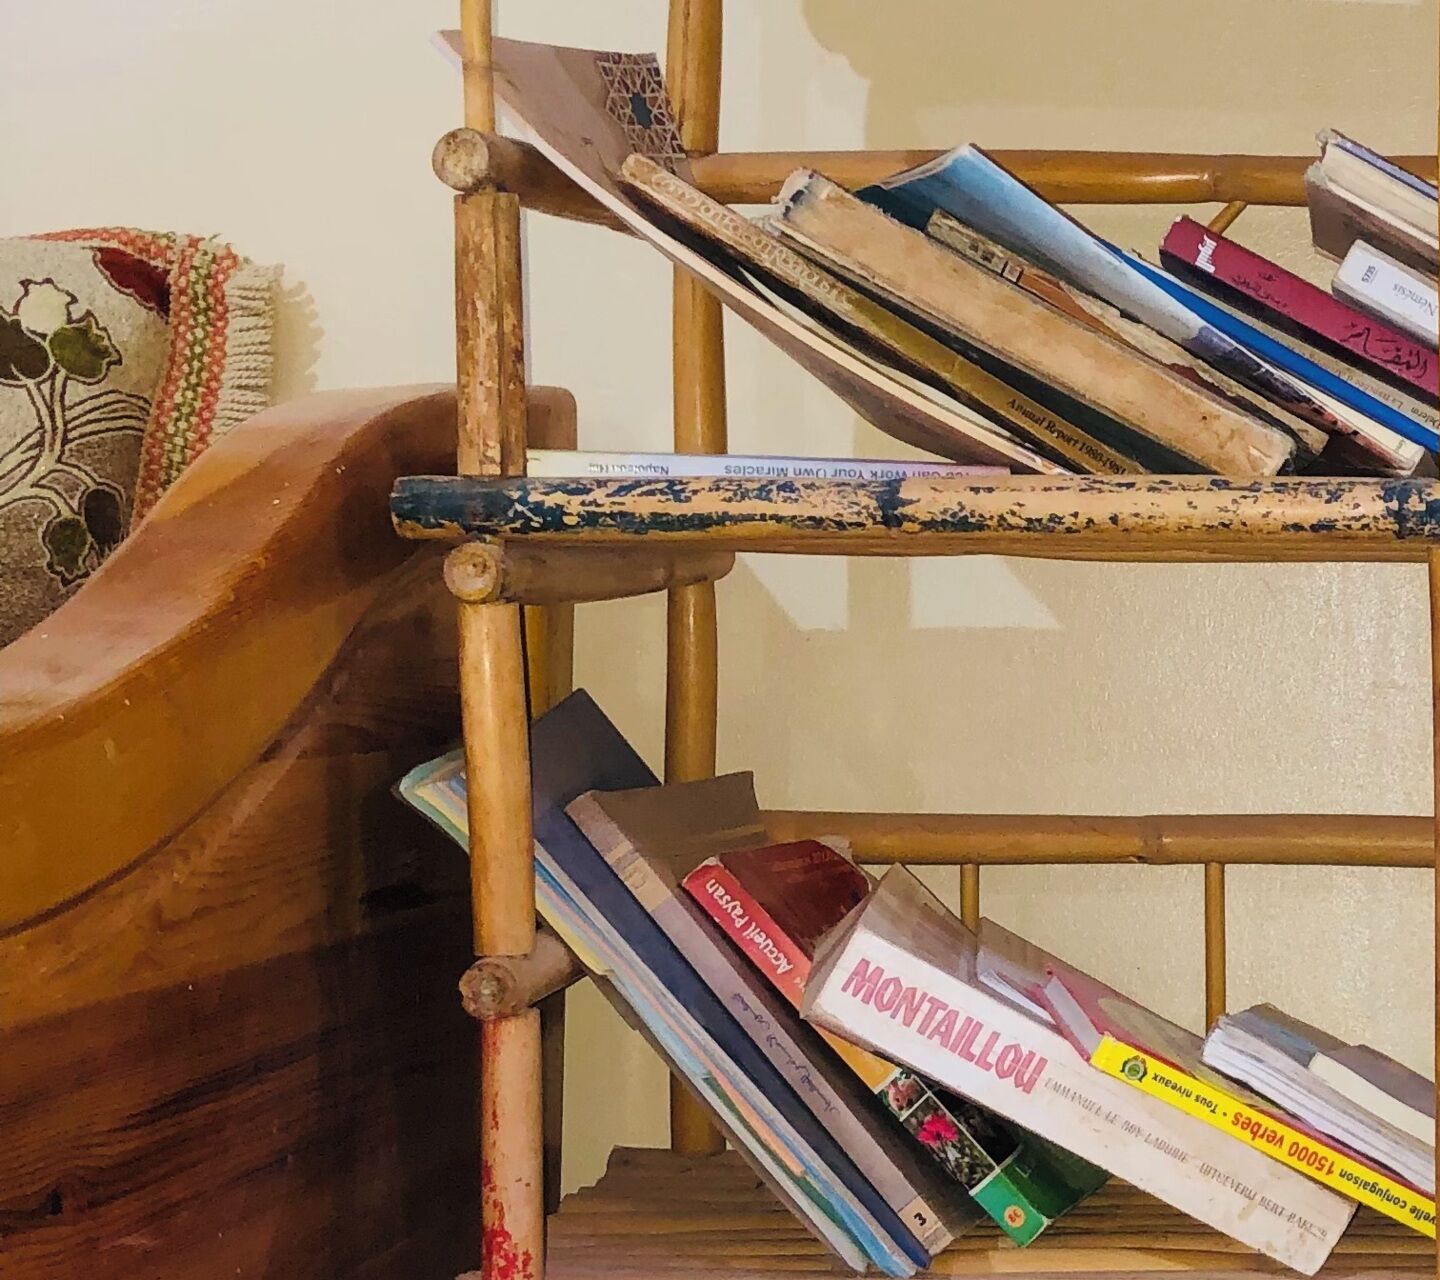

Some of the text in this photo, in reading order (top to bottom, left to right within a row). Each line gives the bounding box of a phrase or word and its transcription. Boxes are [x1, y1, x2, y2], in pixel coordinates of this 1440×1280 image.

[1390, 280, 1439, 317] Némésis
[1005, 396, 1046, 427] Annual
[1042, 419, 1081, 449] Report
[611, 462, 668, 475] Napoleon
[724, 464, 787, 478] Miracles
[793, 466, 826, 478] Own
[831, 466, 863, 479] Your
[870, 468, 907, 481] Work
[701, 875, 752, 928] Paysan
[740, 920, 795, 978] Accueil
[839, 954, 1049, 1096] MONTAILLOU
[1150, 1071, 1193, 1100] niveaux
[1191, 1092, 1220, 1113] Tous
[1043, 1076, 1102, 1116] EMMANUEL
[1103, 1109, 1119, 1125] LE
[1143, 1131, 1189, 1164] LADURIE
[1198, 1162, 1257, 1201] UITGEVERIJ
[1257, 1195, 1285, 1217] BERT
[1227, 1110, 1286, 1152] verbes
[1285, 1139, 1338, 1176] 15000
[1336, 1166, 1409, 1212] conjugaison
[912, 1210, 928, 1227] 3
